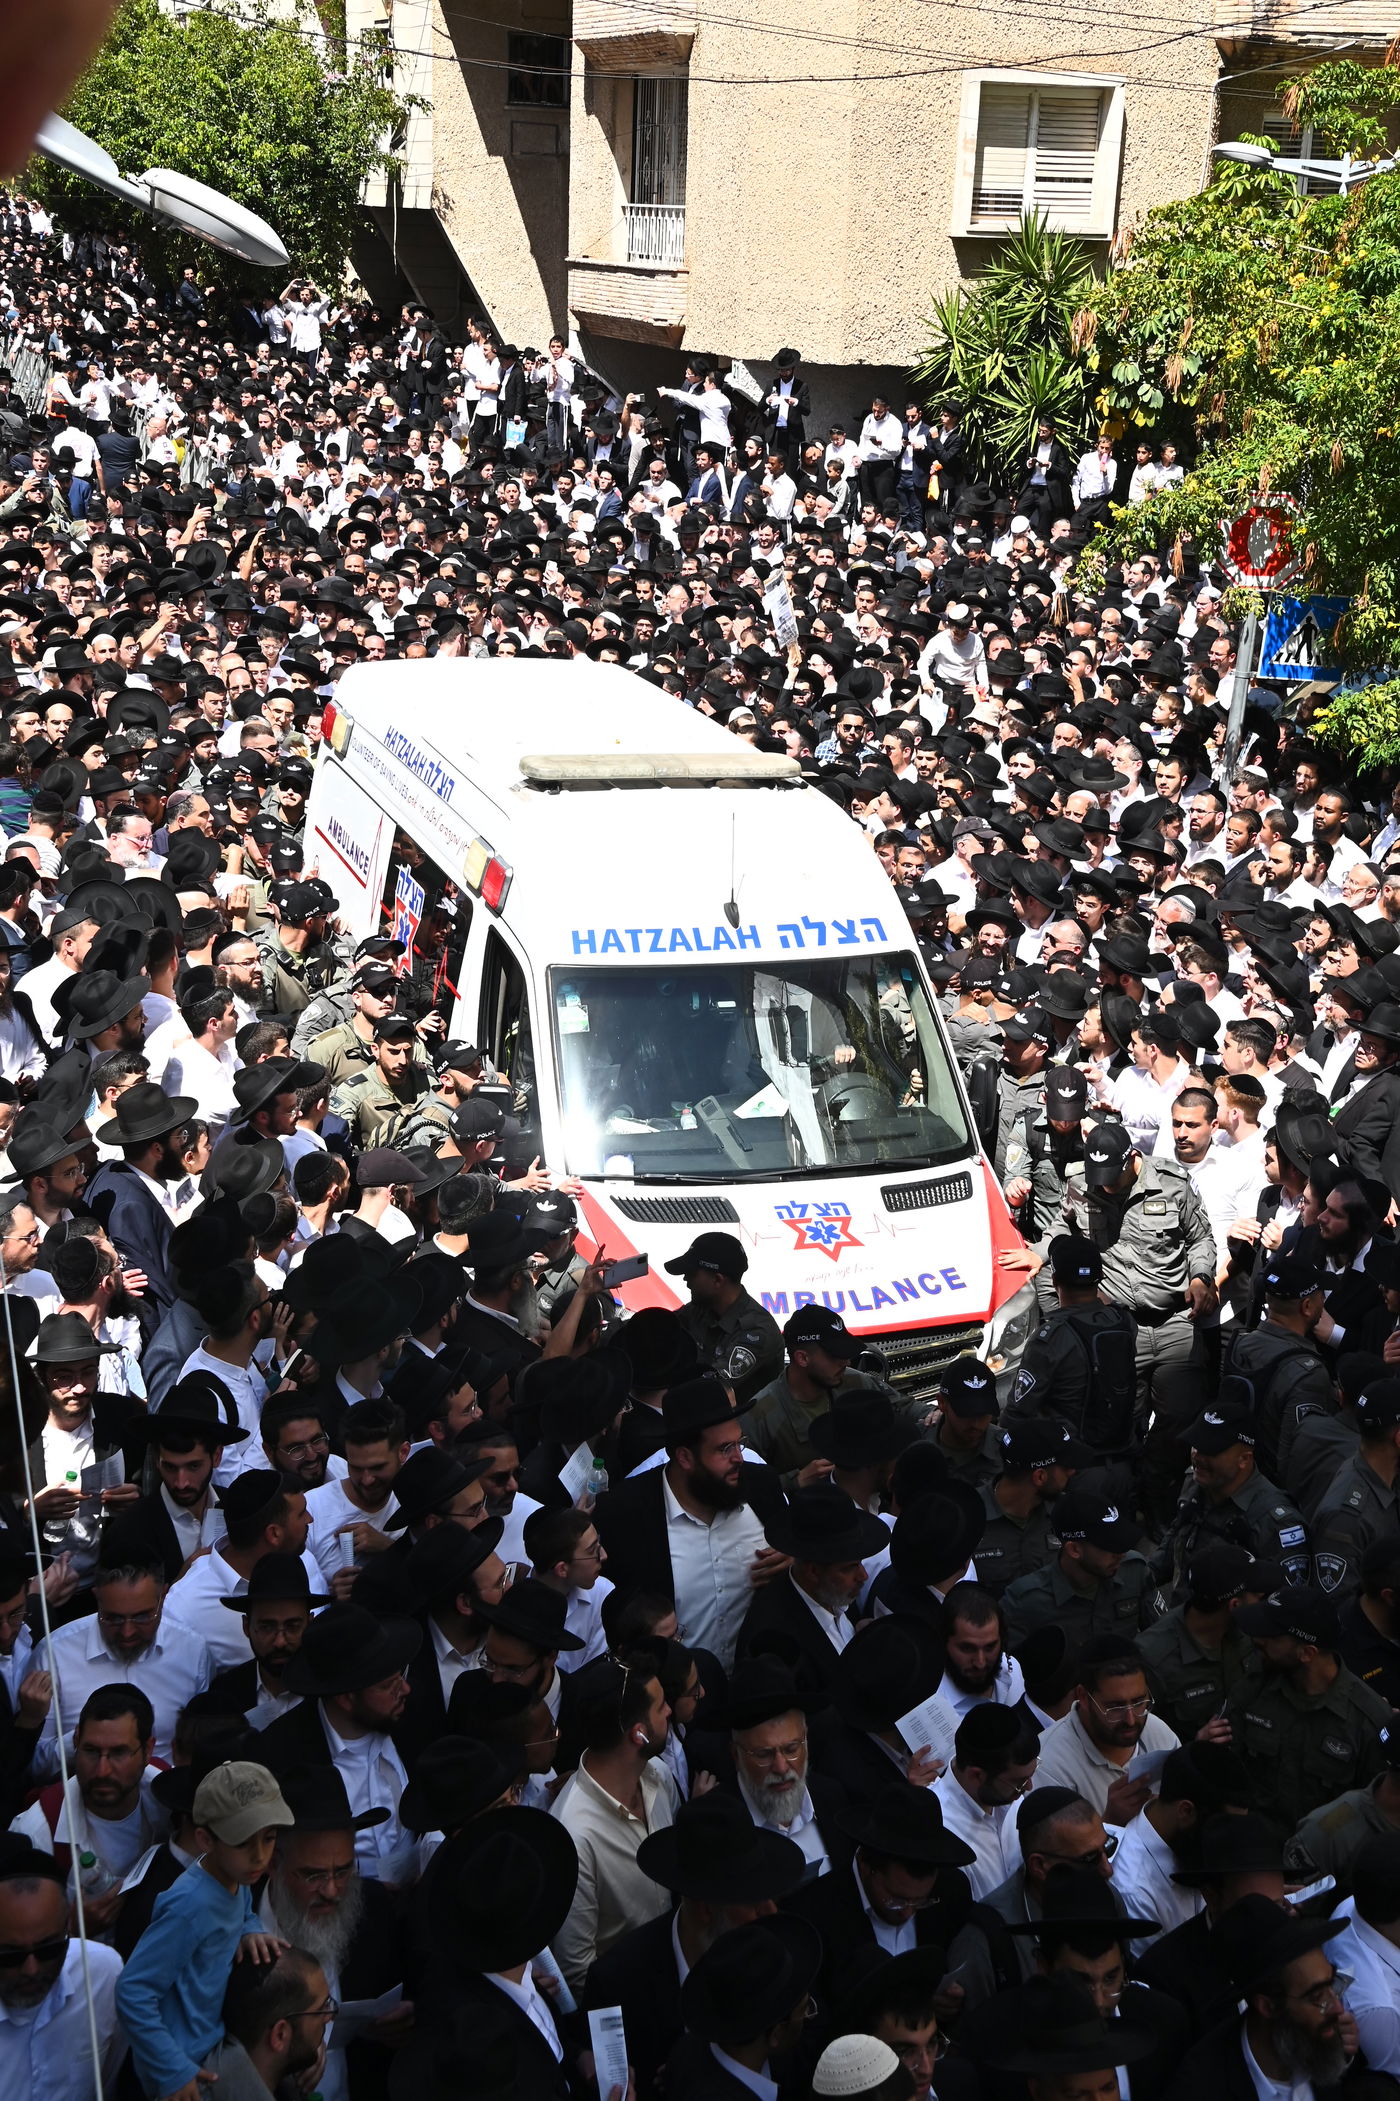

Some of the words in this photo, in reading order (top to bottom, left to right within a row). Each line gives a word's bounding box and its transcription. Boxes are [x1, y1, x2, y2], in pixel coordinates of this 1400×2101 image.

[383, 725, 427, 778] HATZALAH
[423, 760, 455, 802] הצלה
[327, 816, 370, 875] AMBULANCE
[396, 869, 425, 918] הצלה
[304, 906, 320, 917] POLICE
[571, 925, 762, 954] HATZALAH
[776, 915, 889, 949] הצלה
[476, 1129, 496, 1140] POLICE
[774, 1200, 851, 1220] הצלה
[760, 1267, 967, 1314] MBULANCE
[1299, 1282, 1319, 1298] POLICE
[797, 1334, 821, 1342] POLICE
[1030, 1456, 1057, 1468] POLICE
[1061, 1530, 1087, 1539] POLICE
[1288, 1626, 1317, 1643] משטרה
